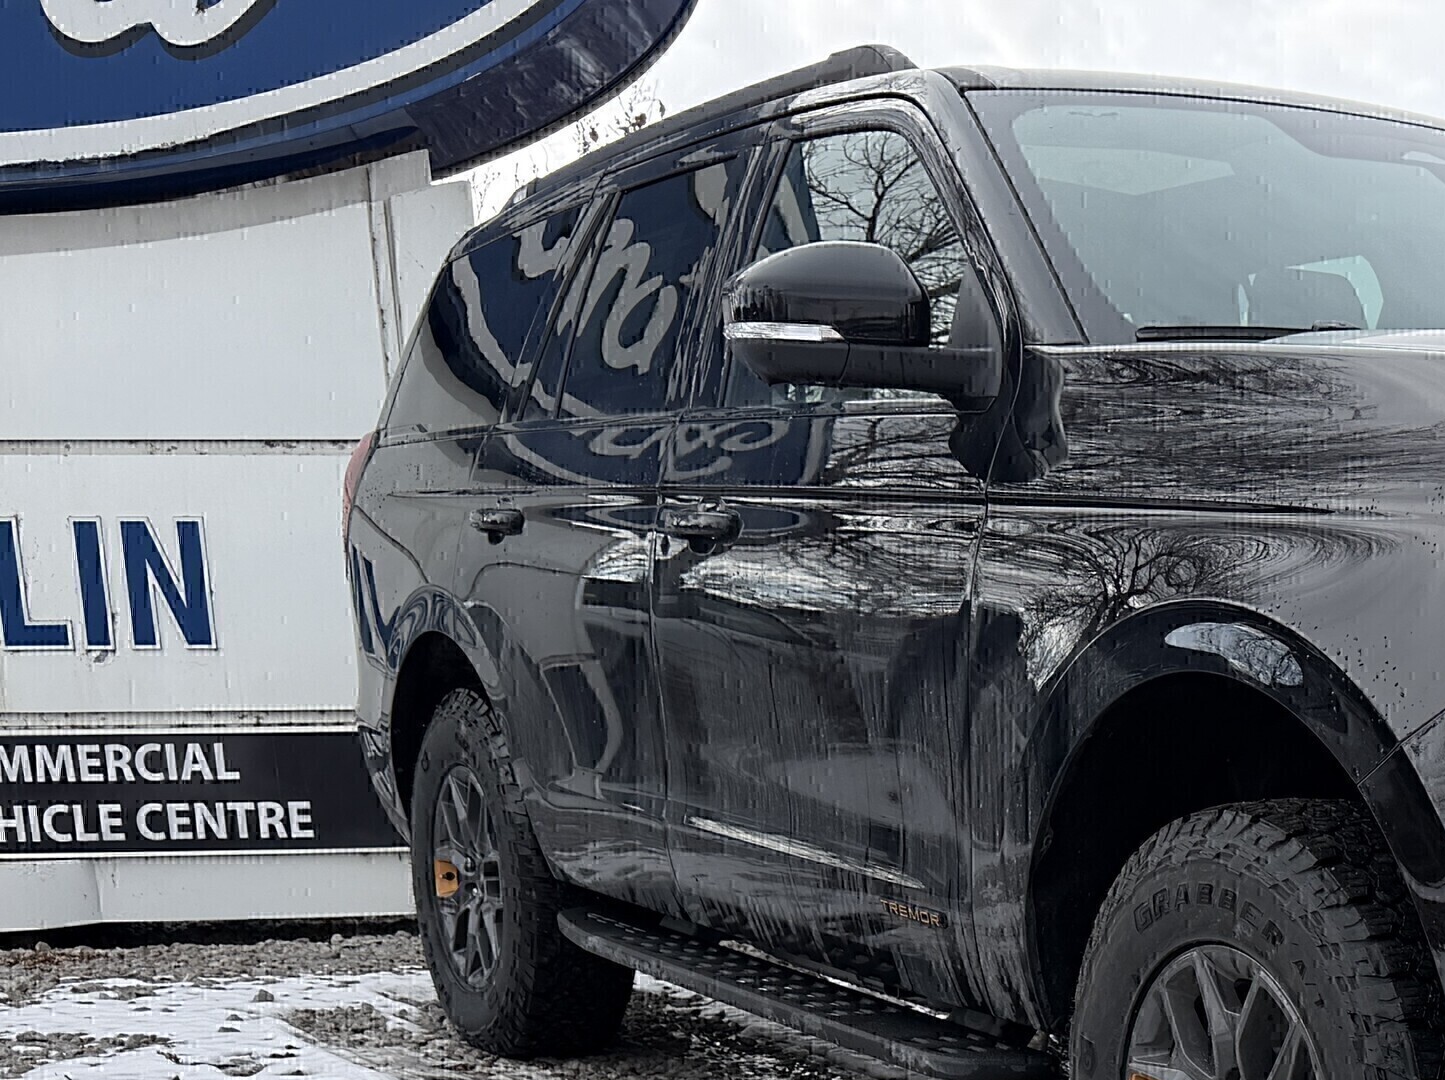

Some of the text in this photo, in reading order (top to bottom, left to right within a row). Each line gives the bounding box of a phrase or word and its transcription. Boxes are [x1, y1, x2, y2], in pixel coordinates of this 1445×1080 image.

[136, 800, 316, 841] CENTRE
[879, 898, 941, 928] TREMOR
[1133, 882, 1286, 947] GRABBER
